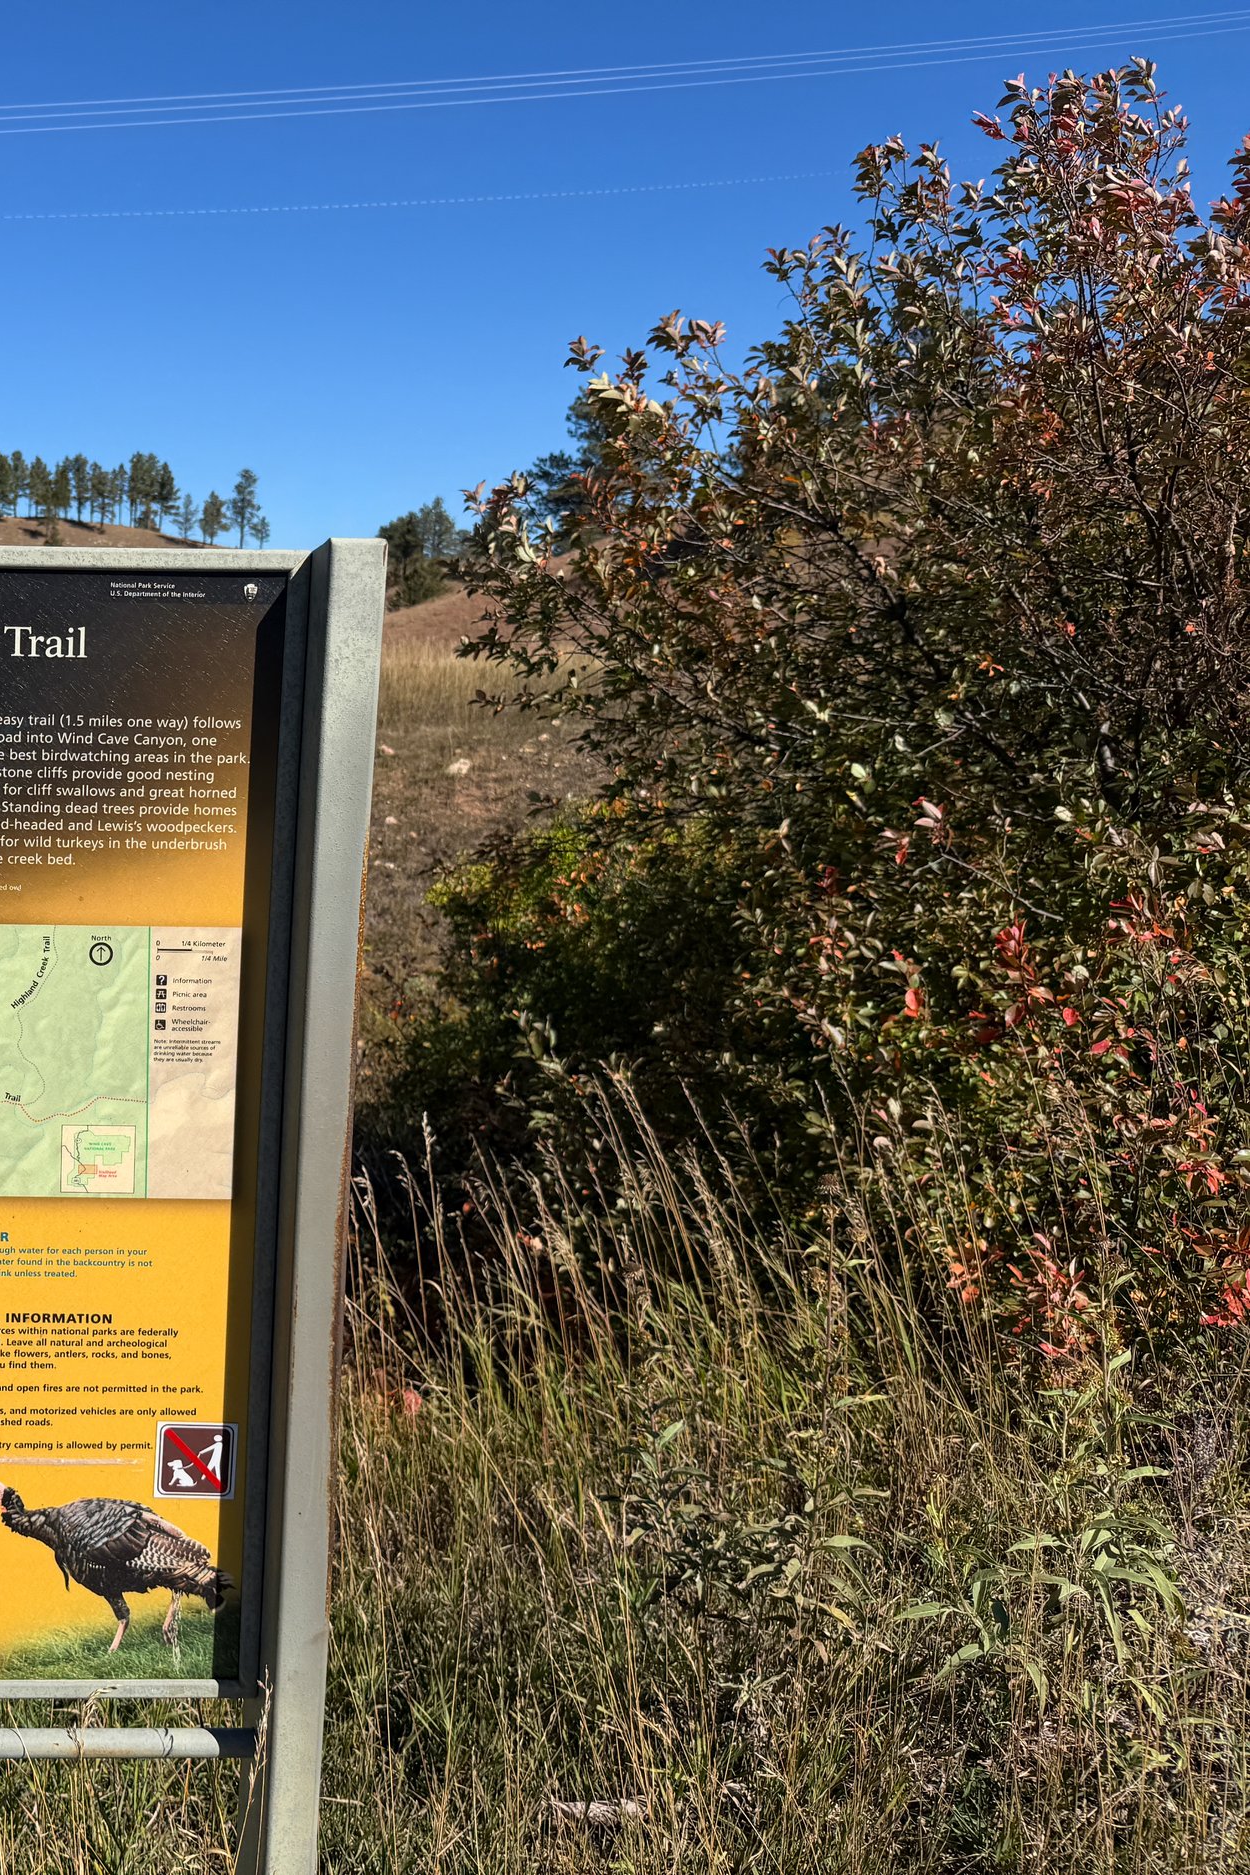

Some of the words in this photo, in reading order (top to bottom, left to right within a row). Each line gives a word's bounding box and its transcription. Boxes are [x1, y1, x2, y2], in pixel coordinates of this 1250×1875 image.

[110, 590, 122, 599] U.S.
[4, 626, 87, 658] Trail
[28, 714, 54, 726] trail
[60, 714, 84, 728] (1.5
[89, 714, 122, 727] miles
[127, 718, 152, 728] one
[156, 716, 188, 731] way)
[193, 716, 241, 729] follows
[27, 731, 53, 743] into
[57, 732, 93, 744] Wind
[98, 733, 129, 745] Cave
[134, 733, 186, 748] Canyon,
[192, 737, 217, 746] one
[10, 748, 37, 761] best
[42, 749, 129, 765] birdwatching
[134, 753, 169, 763] areas
[174, 751, 185, 763] in
[190, 751, 212, 764] the
[217, 752, 250, 766] park.
[37, 766, 68, 779] cliffs
[72, 767, 122, 782] provide
[127, 768, 161, 783] good
[166, 769, 214, 784] nesting
[68, 819, 93, 831] and
[98, 820, 142, 832] Lewis's
[146, 821, 236, 835] woodpeckers.
[11, 981, 38, 1009] Highland
[37, 957, 49, 978] Creek
[4, 1092, 21, 1102] Trail
[46, 1246, 59, 1254] for
[6, 1313, 112, 1324] INFORMATION
[14, 1441, 53, 1451] camping
[56, 1441, 63, 1449] is
[66, 1441, 103, 1449] allowed
[106, 1441, 117, 1451] by
[120, 1441, 153, 1451] permit.
